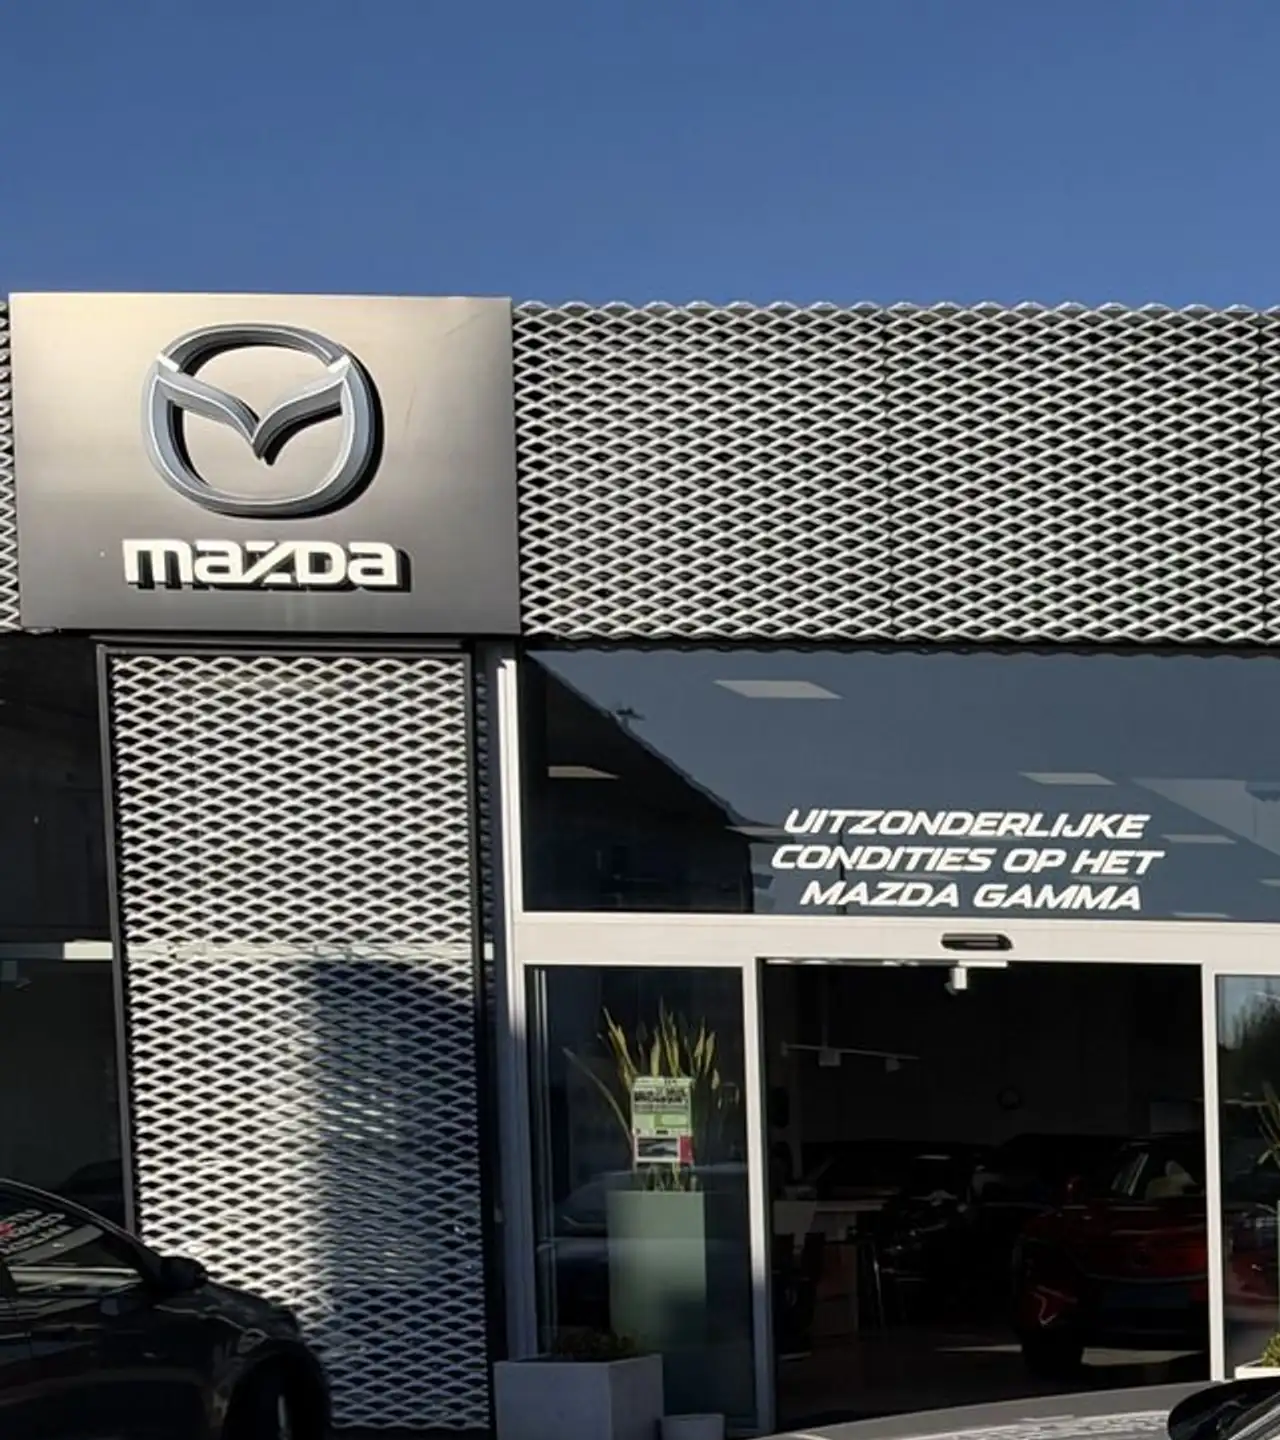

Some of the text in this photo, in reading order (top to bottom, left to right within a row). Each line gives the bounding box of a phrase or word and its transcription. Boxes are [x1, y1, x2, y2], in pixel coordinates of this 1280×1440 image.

[122, 538, 399, 586] mazda
[783, 808, 1150, 840] UITZONDERLIJKE
[771, 844, 1165, 875] CONDITIES OP HET
[800, 880, 1141, 911] MAZDA GAMMA
